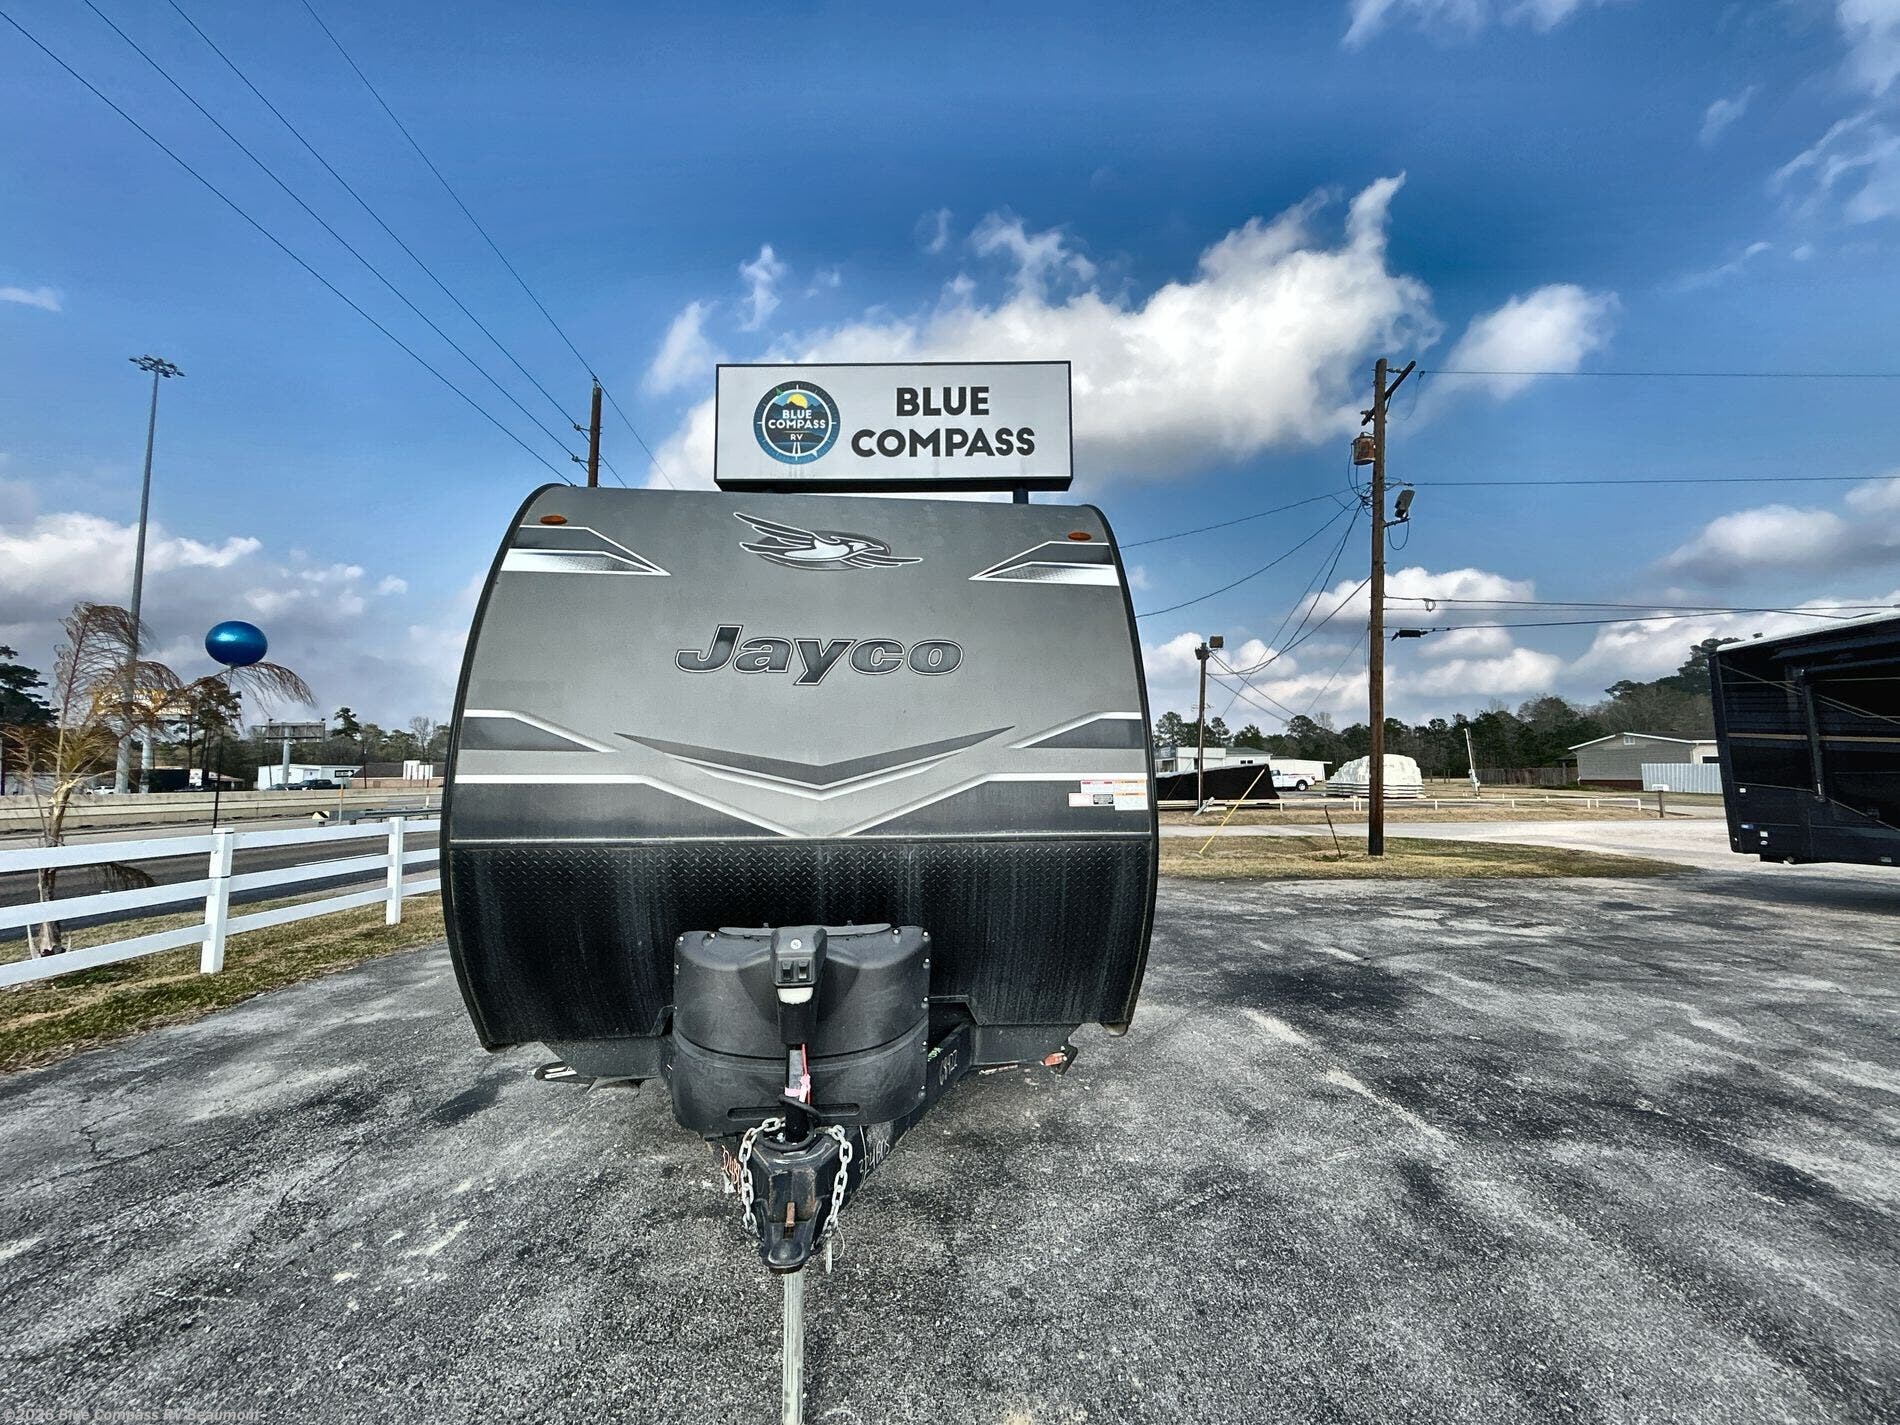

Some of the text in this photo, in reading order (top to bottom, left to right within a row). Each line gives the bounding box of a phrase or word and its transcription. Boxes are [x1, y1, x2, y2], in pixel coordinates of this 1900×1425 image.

[896, 386, 990, 417] BLUE
[768, 419, 826, 429] COMPASS
[782, 409, 812, 419] BLUE
[790, 433, 804, 441] RV
[851, 427, 1036, 458] COMPASS
[674, 624, 965, 686] Jayco
